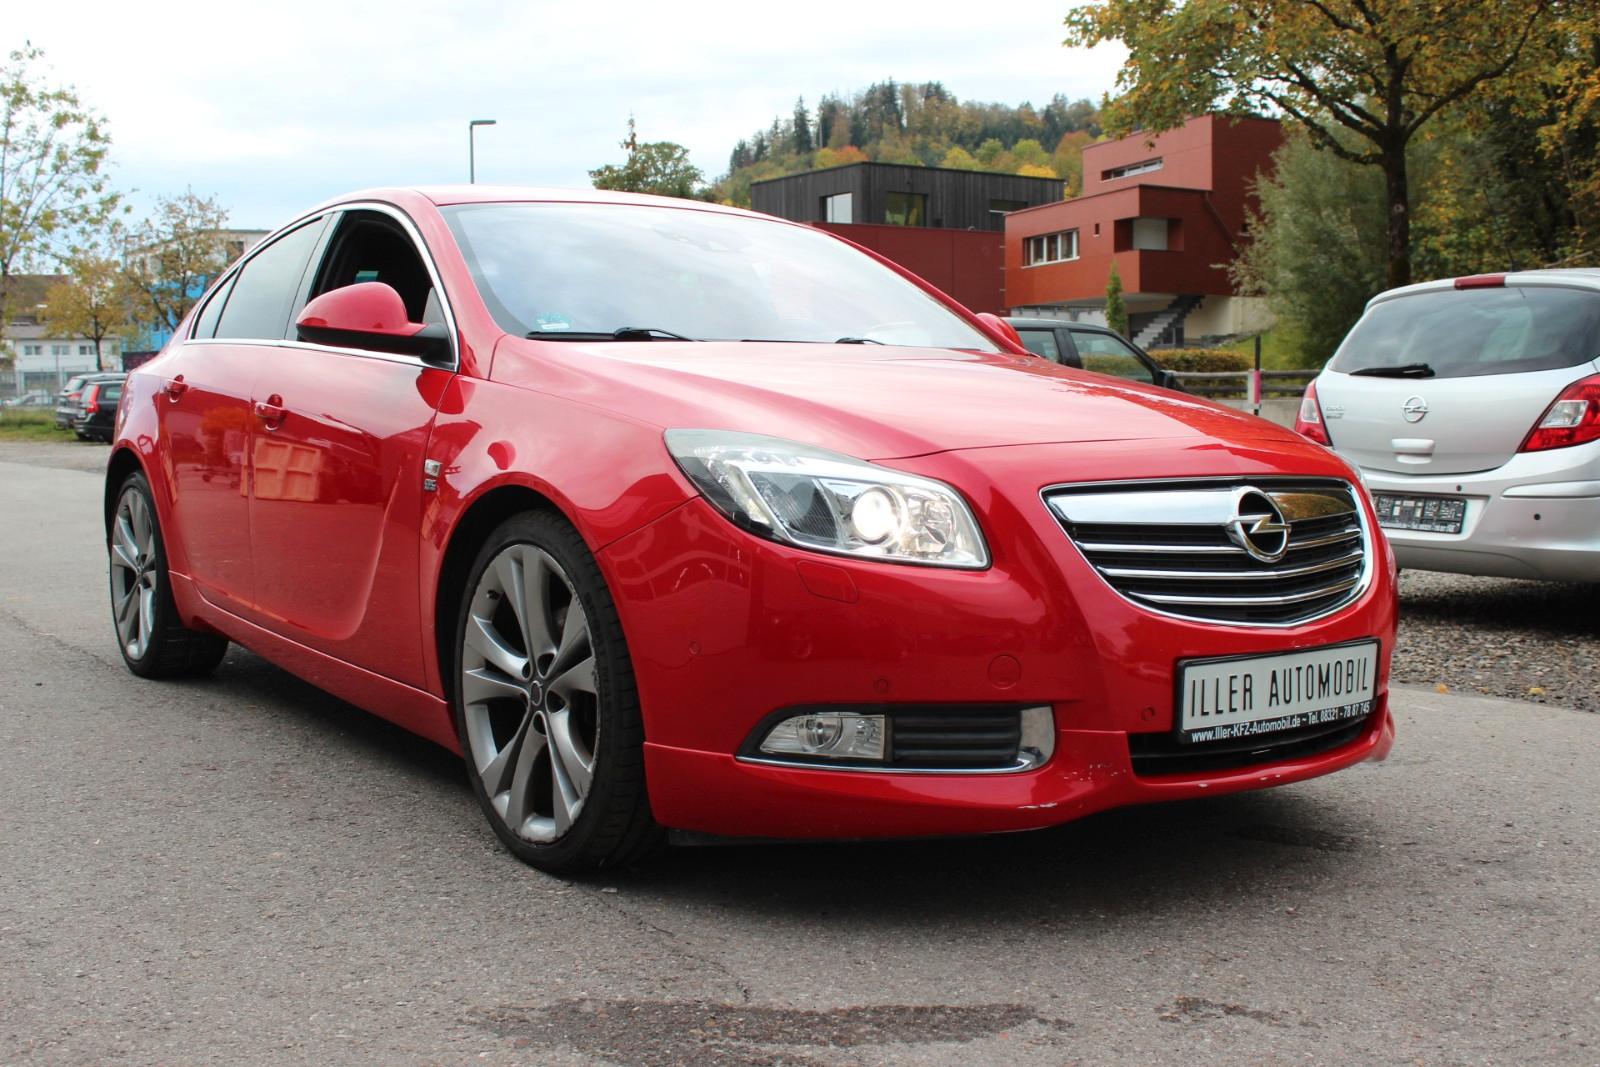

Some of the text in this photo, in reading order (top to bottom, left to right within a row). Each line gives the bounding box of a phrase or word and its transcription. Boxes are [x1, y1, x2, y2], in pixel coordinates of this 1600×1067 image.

[1192, 657, 1368, 717] ILLER AUTOMOBIL
[1308, 712, 1319, 725] Tel.
[1320, 708, 1339, 722] 08321
[1352, 703, 1359, 716] 87
